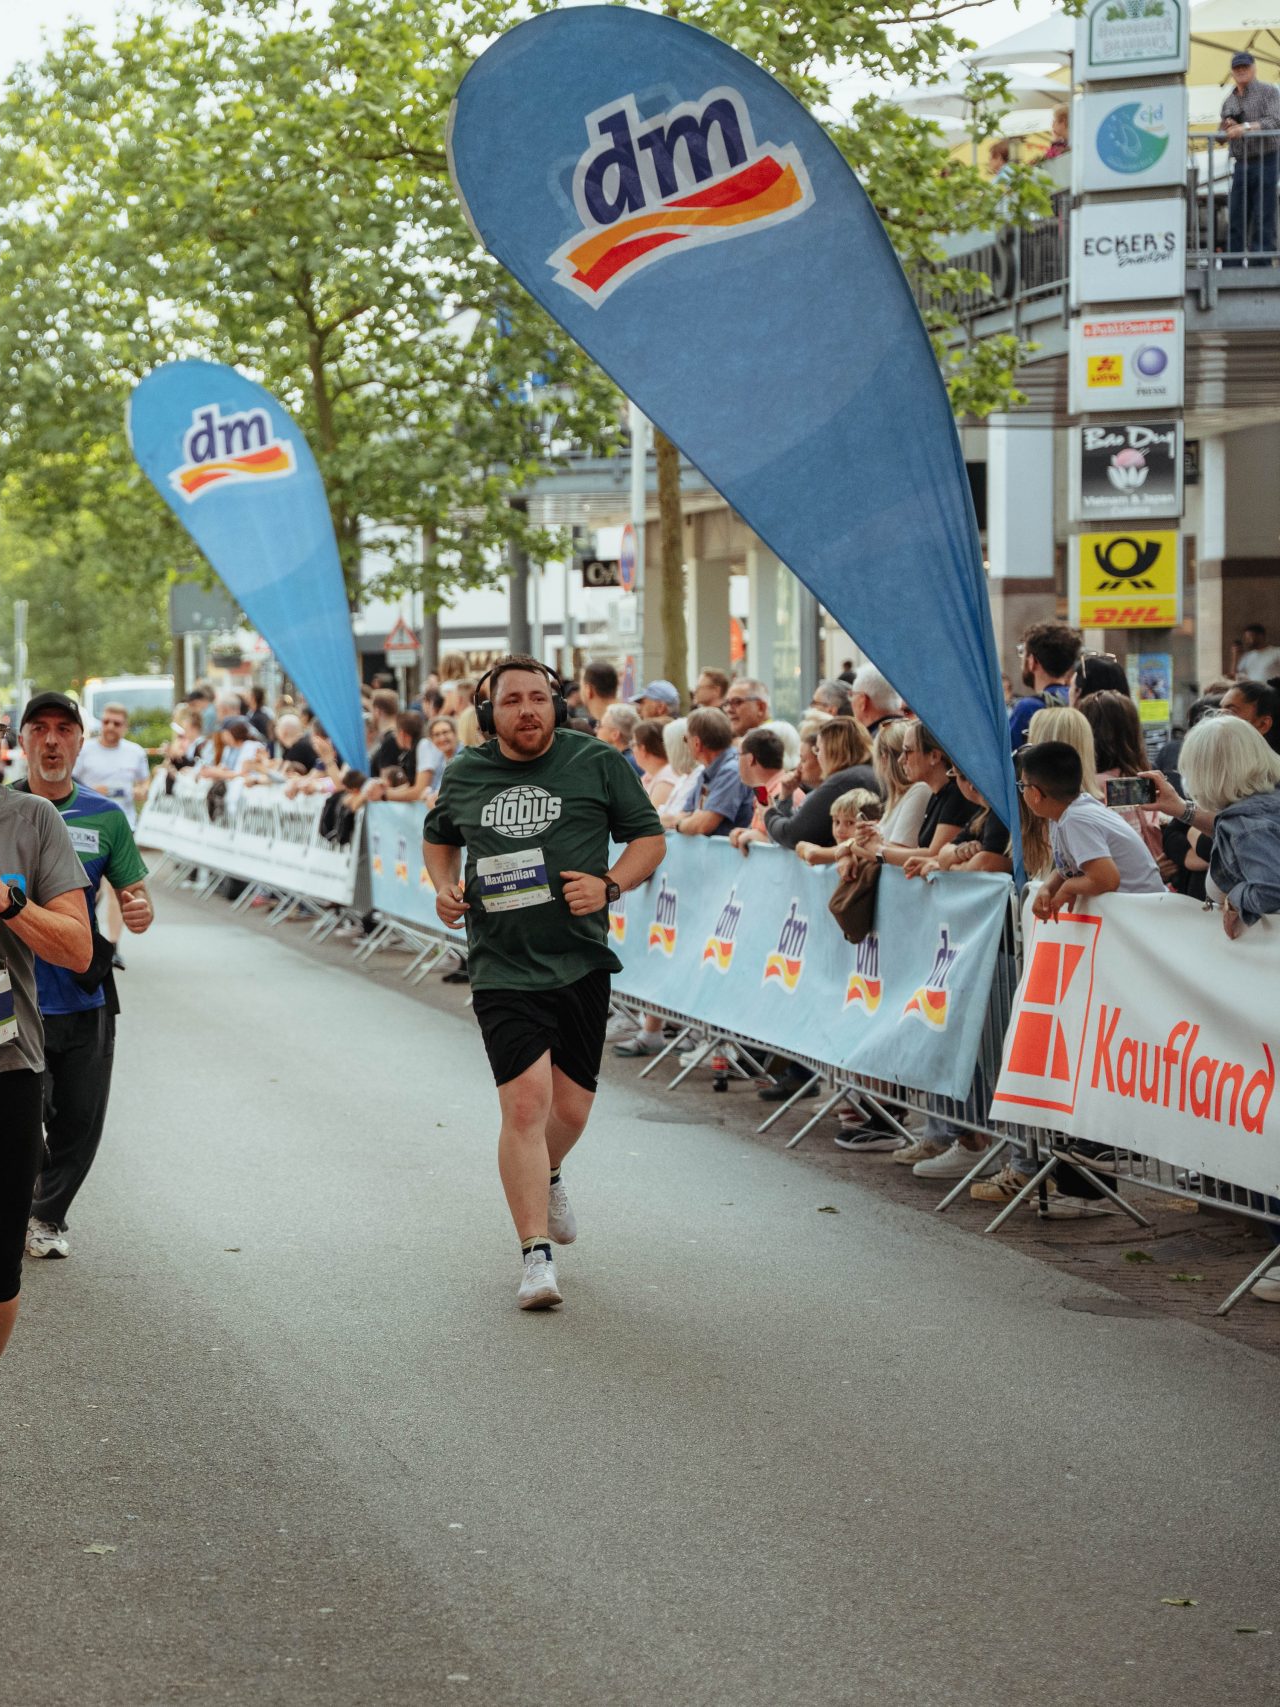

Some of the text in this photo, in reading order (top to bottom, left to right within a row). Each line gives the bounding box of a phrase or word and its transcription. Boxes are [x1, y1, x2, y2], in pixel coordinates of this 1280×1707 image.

[585, 109, 748, 224] dm
[1084, 232, 1175, 256] ECKER'S
[191, 411, 267, 463] dm
[1093, 607, 1162, 624] DHL
[484, 869, 536, 886] Maximilian
[656, 878, 677, 926] dm
[715, 890, 741, 940] dm
[778, 903, 808, 957] dm
[1091, 1004, 1276, 1135] Kaufland
